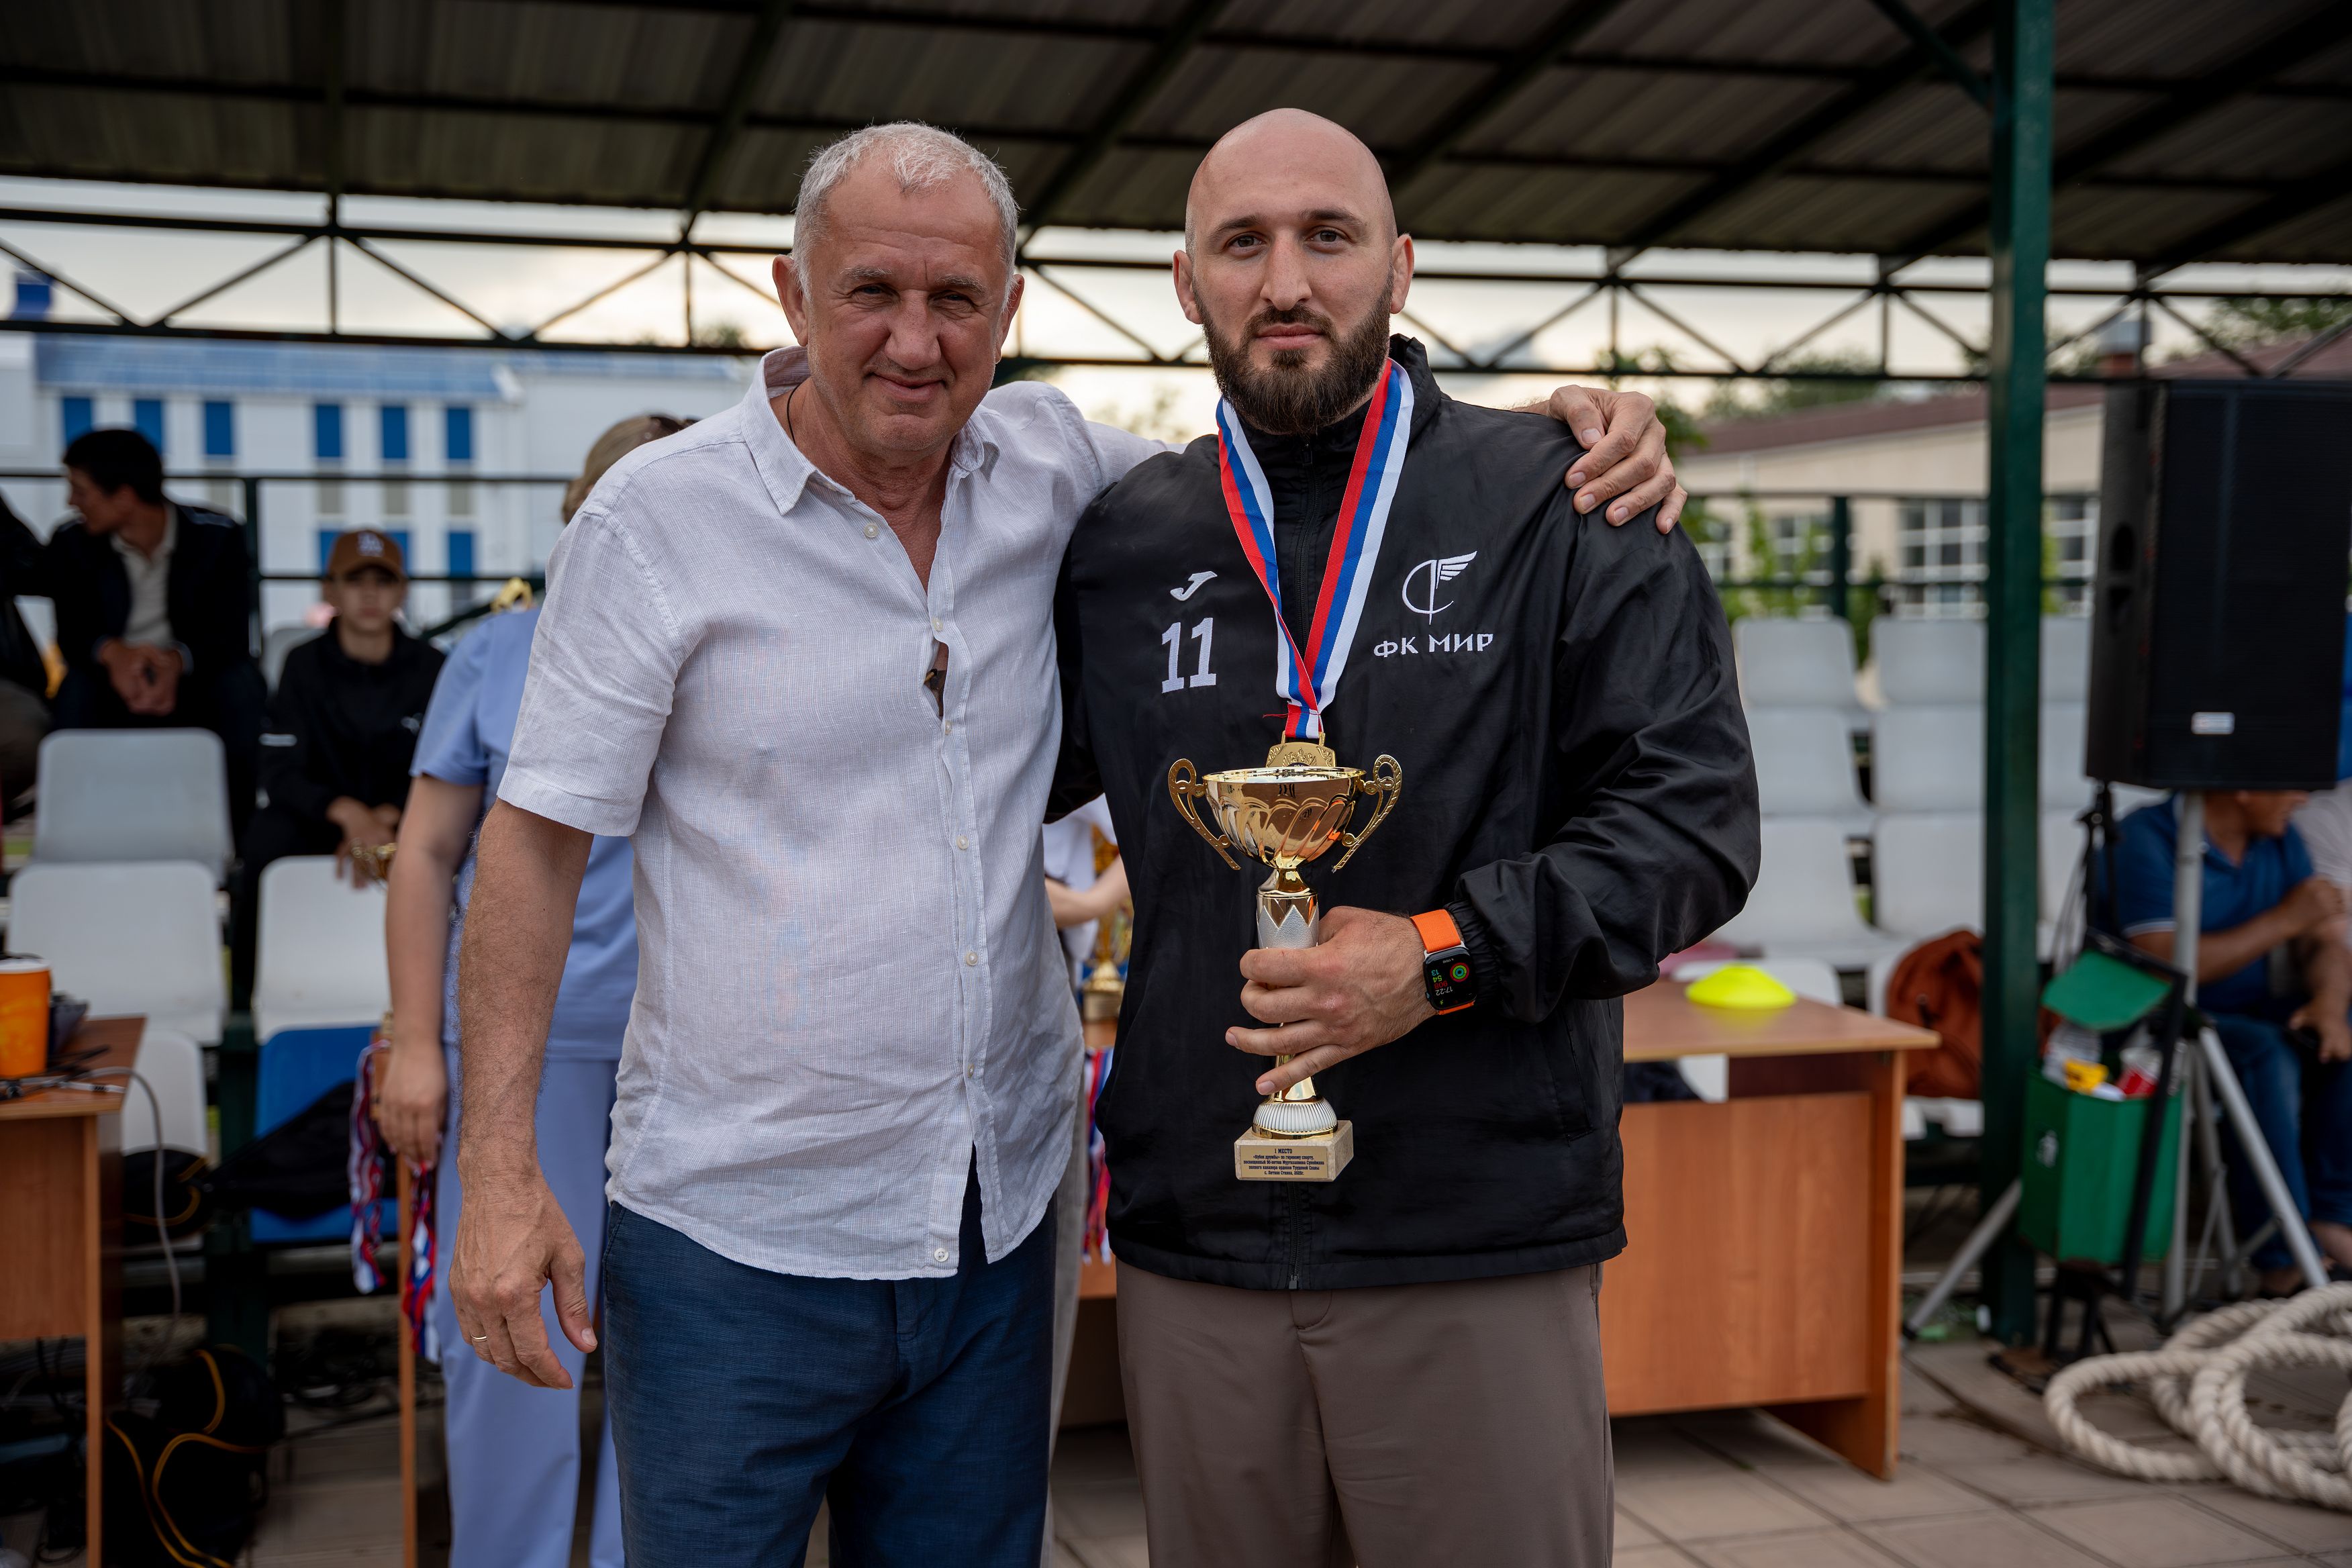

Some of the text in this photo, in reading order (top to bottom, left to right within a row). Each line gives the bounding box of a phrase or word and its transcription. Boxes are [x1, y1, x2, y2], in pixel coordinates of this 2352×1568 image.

[1373, 633, 1494, 658] ФК МИР
[1161, 617, 1218, 693] 11
[1432, 975, 1442, 983] 54
[1434, 980, 1448, 989] 908
[1435, 986, 1453, 996] 17:22
